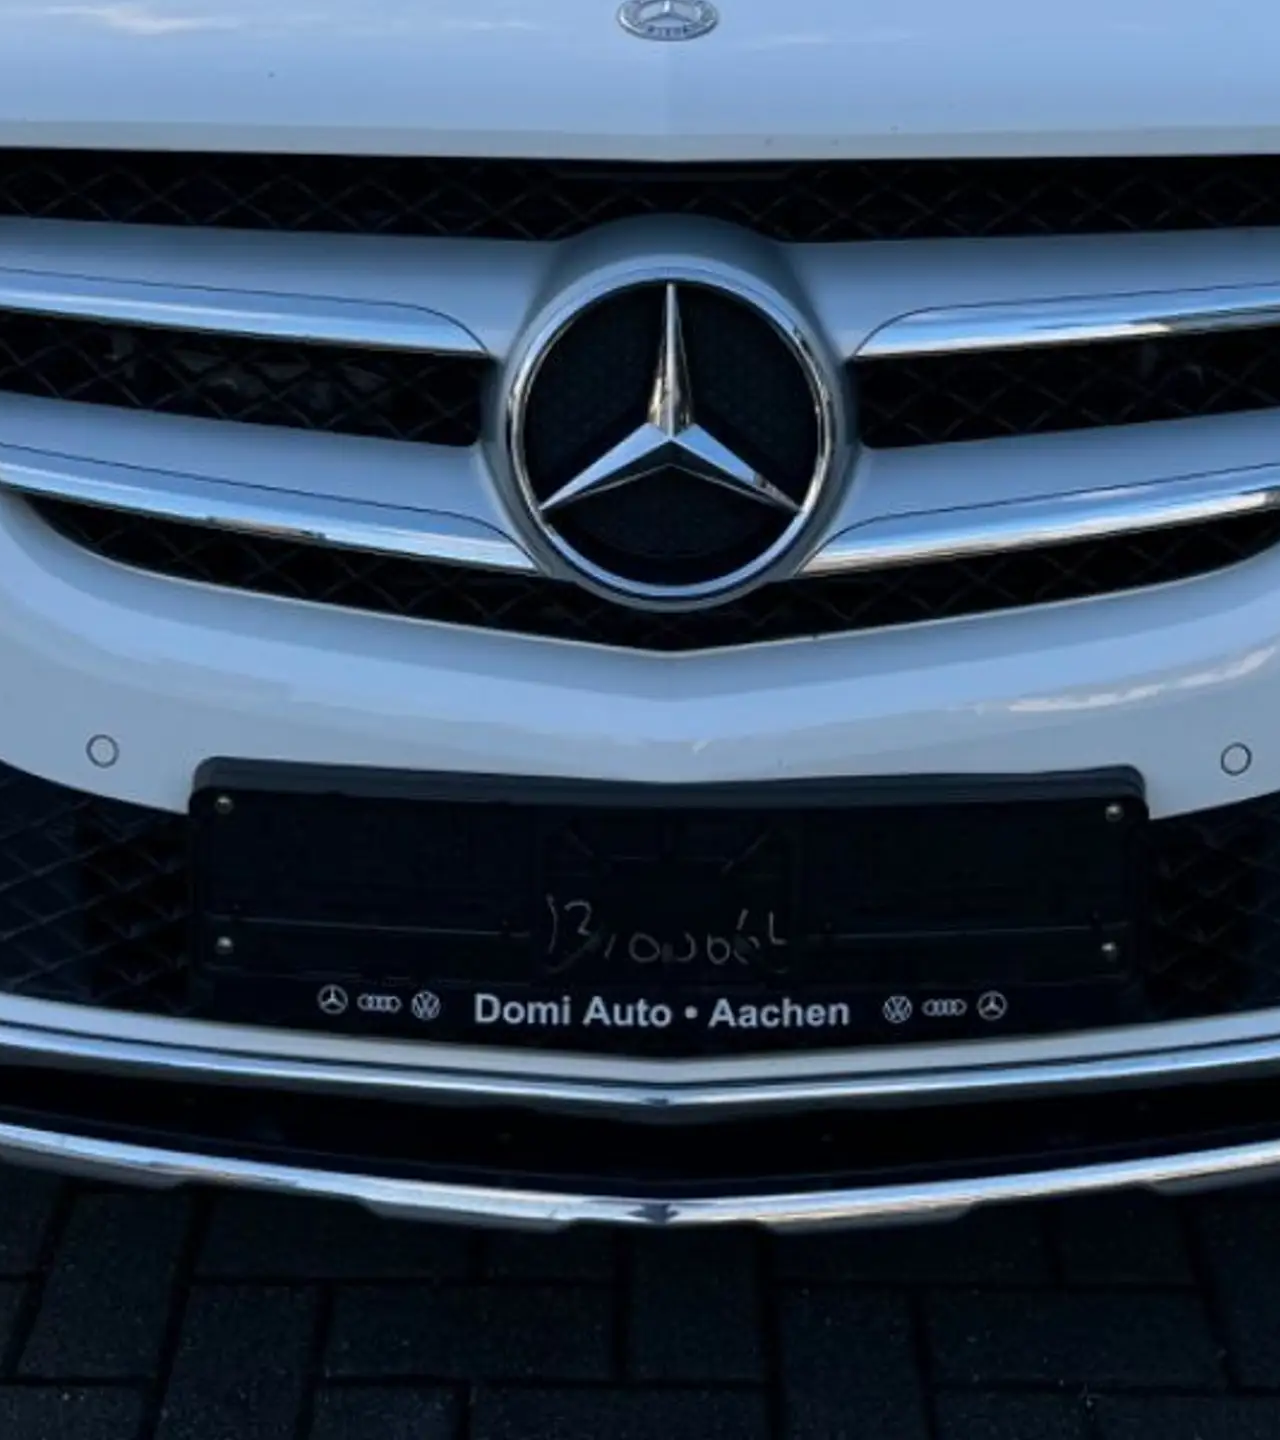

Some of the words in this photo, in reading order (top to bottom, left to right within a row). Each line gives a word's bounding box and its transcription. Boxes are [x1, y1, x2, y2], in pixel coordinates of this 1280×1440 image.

[473, 992, 571, 1025] Domi
[582, 995, 673, 1028] Auto
[707, 997, 850, 1029] Aachen
